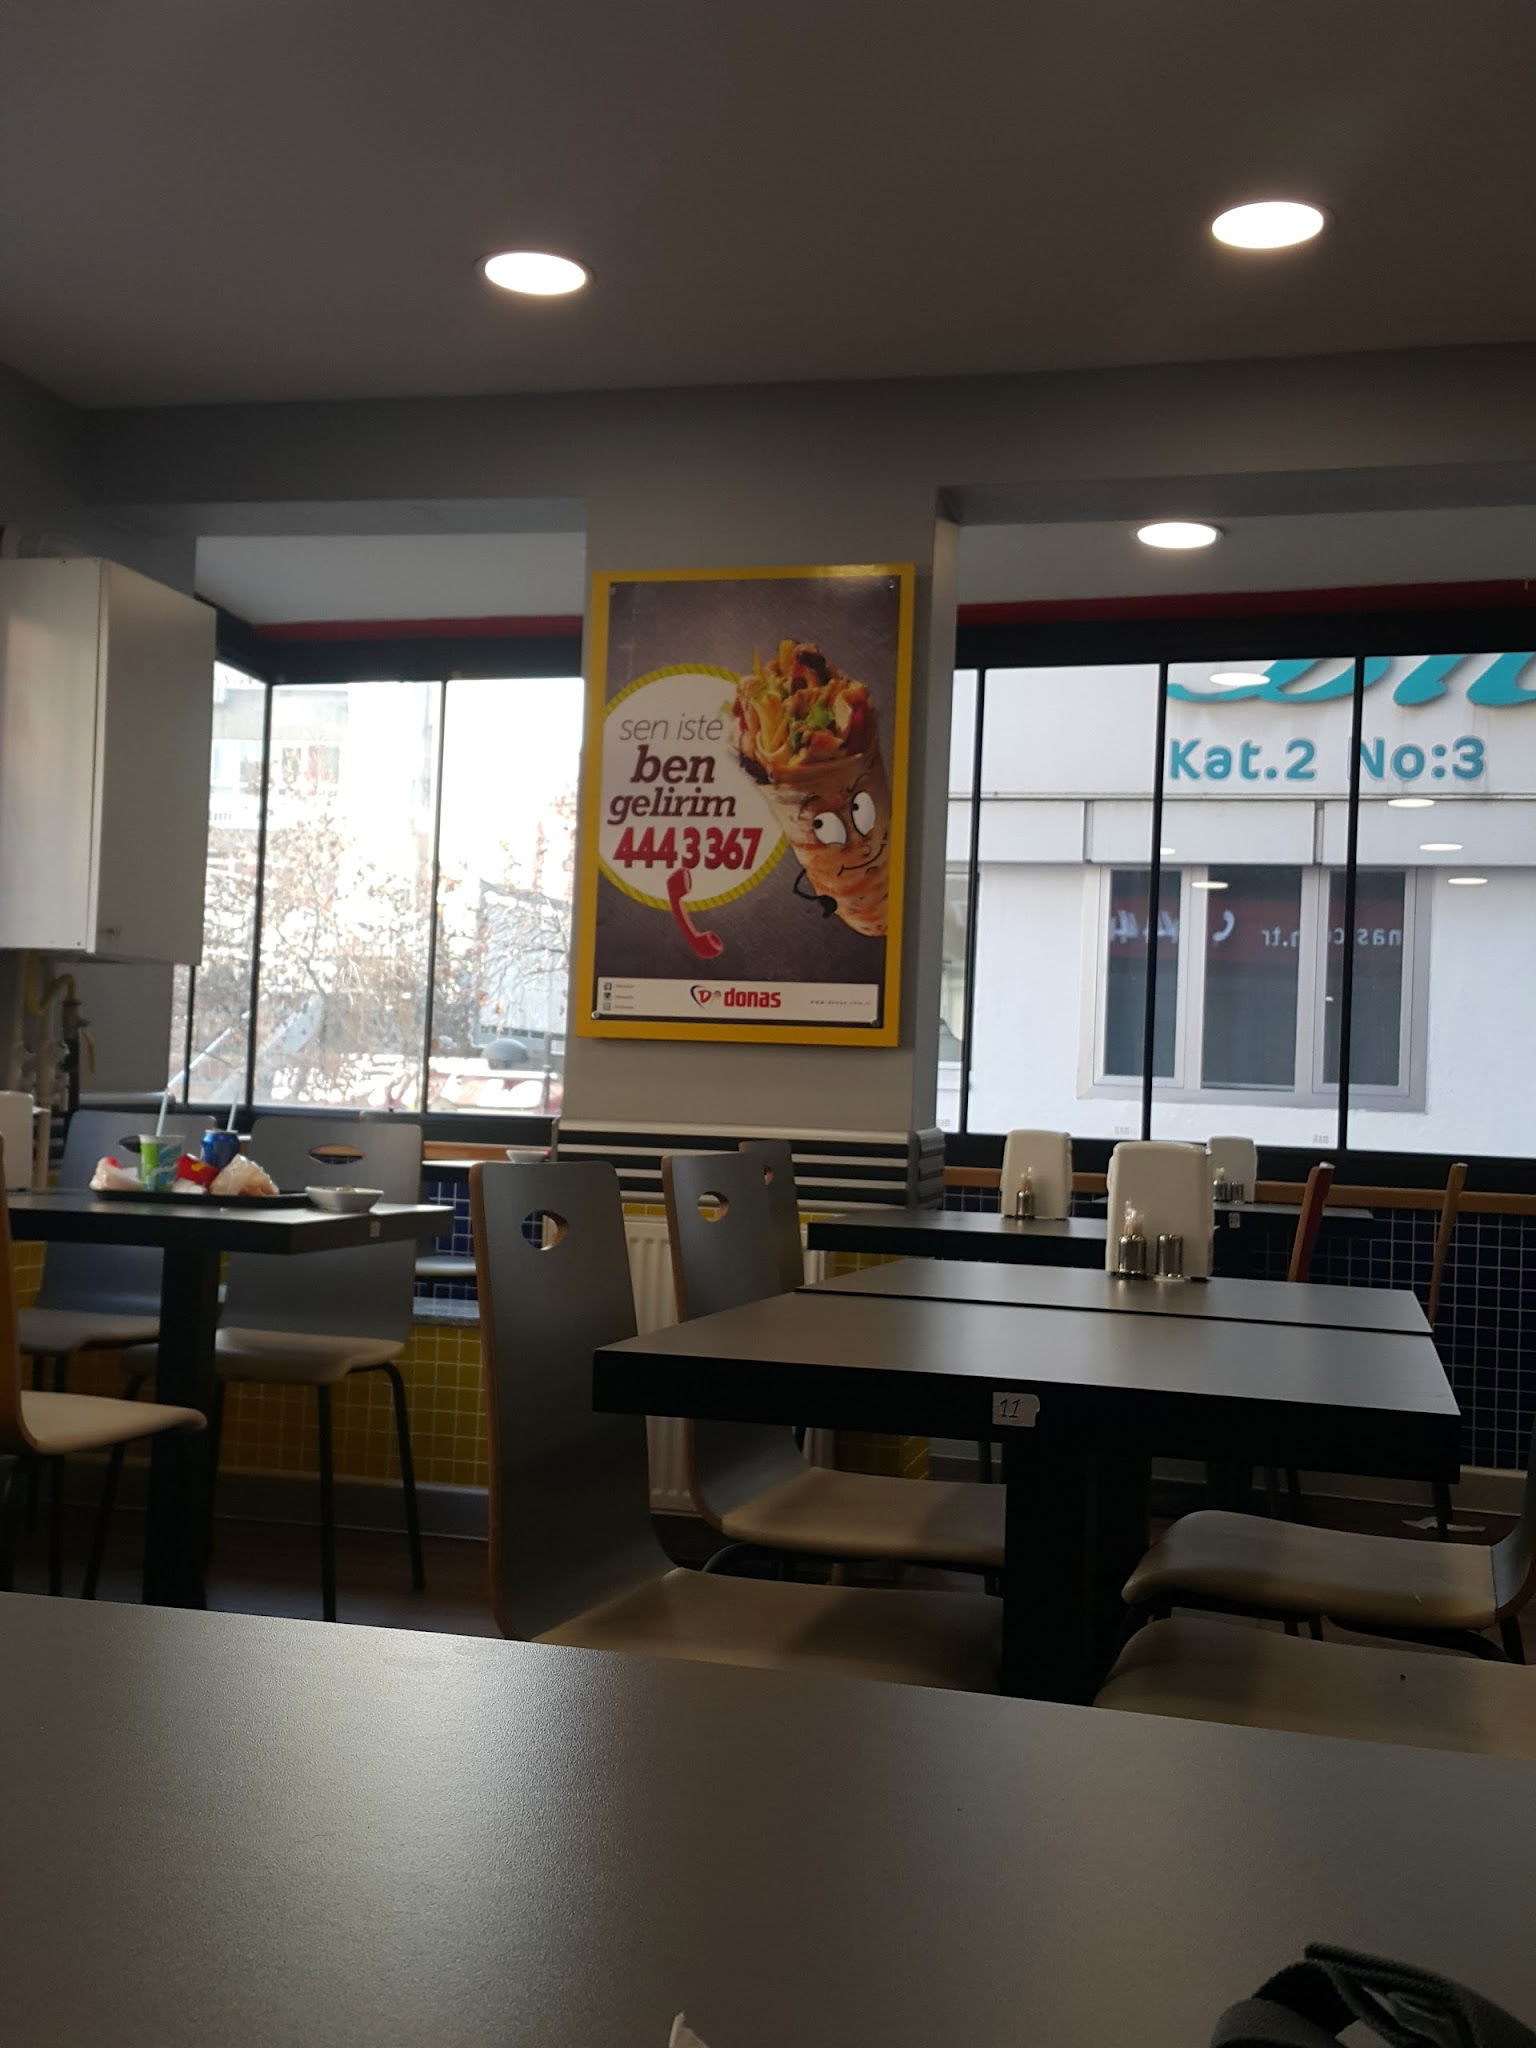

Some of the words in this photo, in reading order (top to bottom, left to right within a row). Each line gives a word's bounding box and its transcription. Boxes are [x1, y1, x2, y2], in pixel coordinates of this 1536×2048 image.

[619, 719, 669, 741] sen
[676, 713, 724, 741] iste
[629, 744, 716, 784] ben
[1168, 738, 1317, 780] Kat.2
[1349, 736, 1486, 780] No:3
[607, 787, 737, 826] gelirim
[724, 987, 782, 1009] donas
[1000, 1399, 1020, 1418] 11
